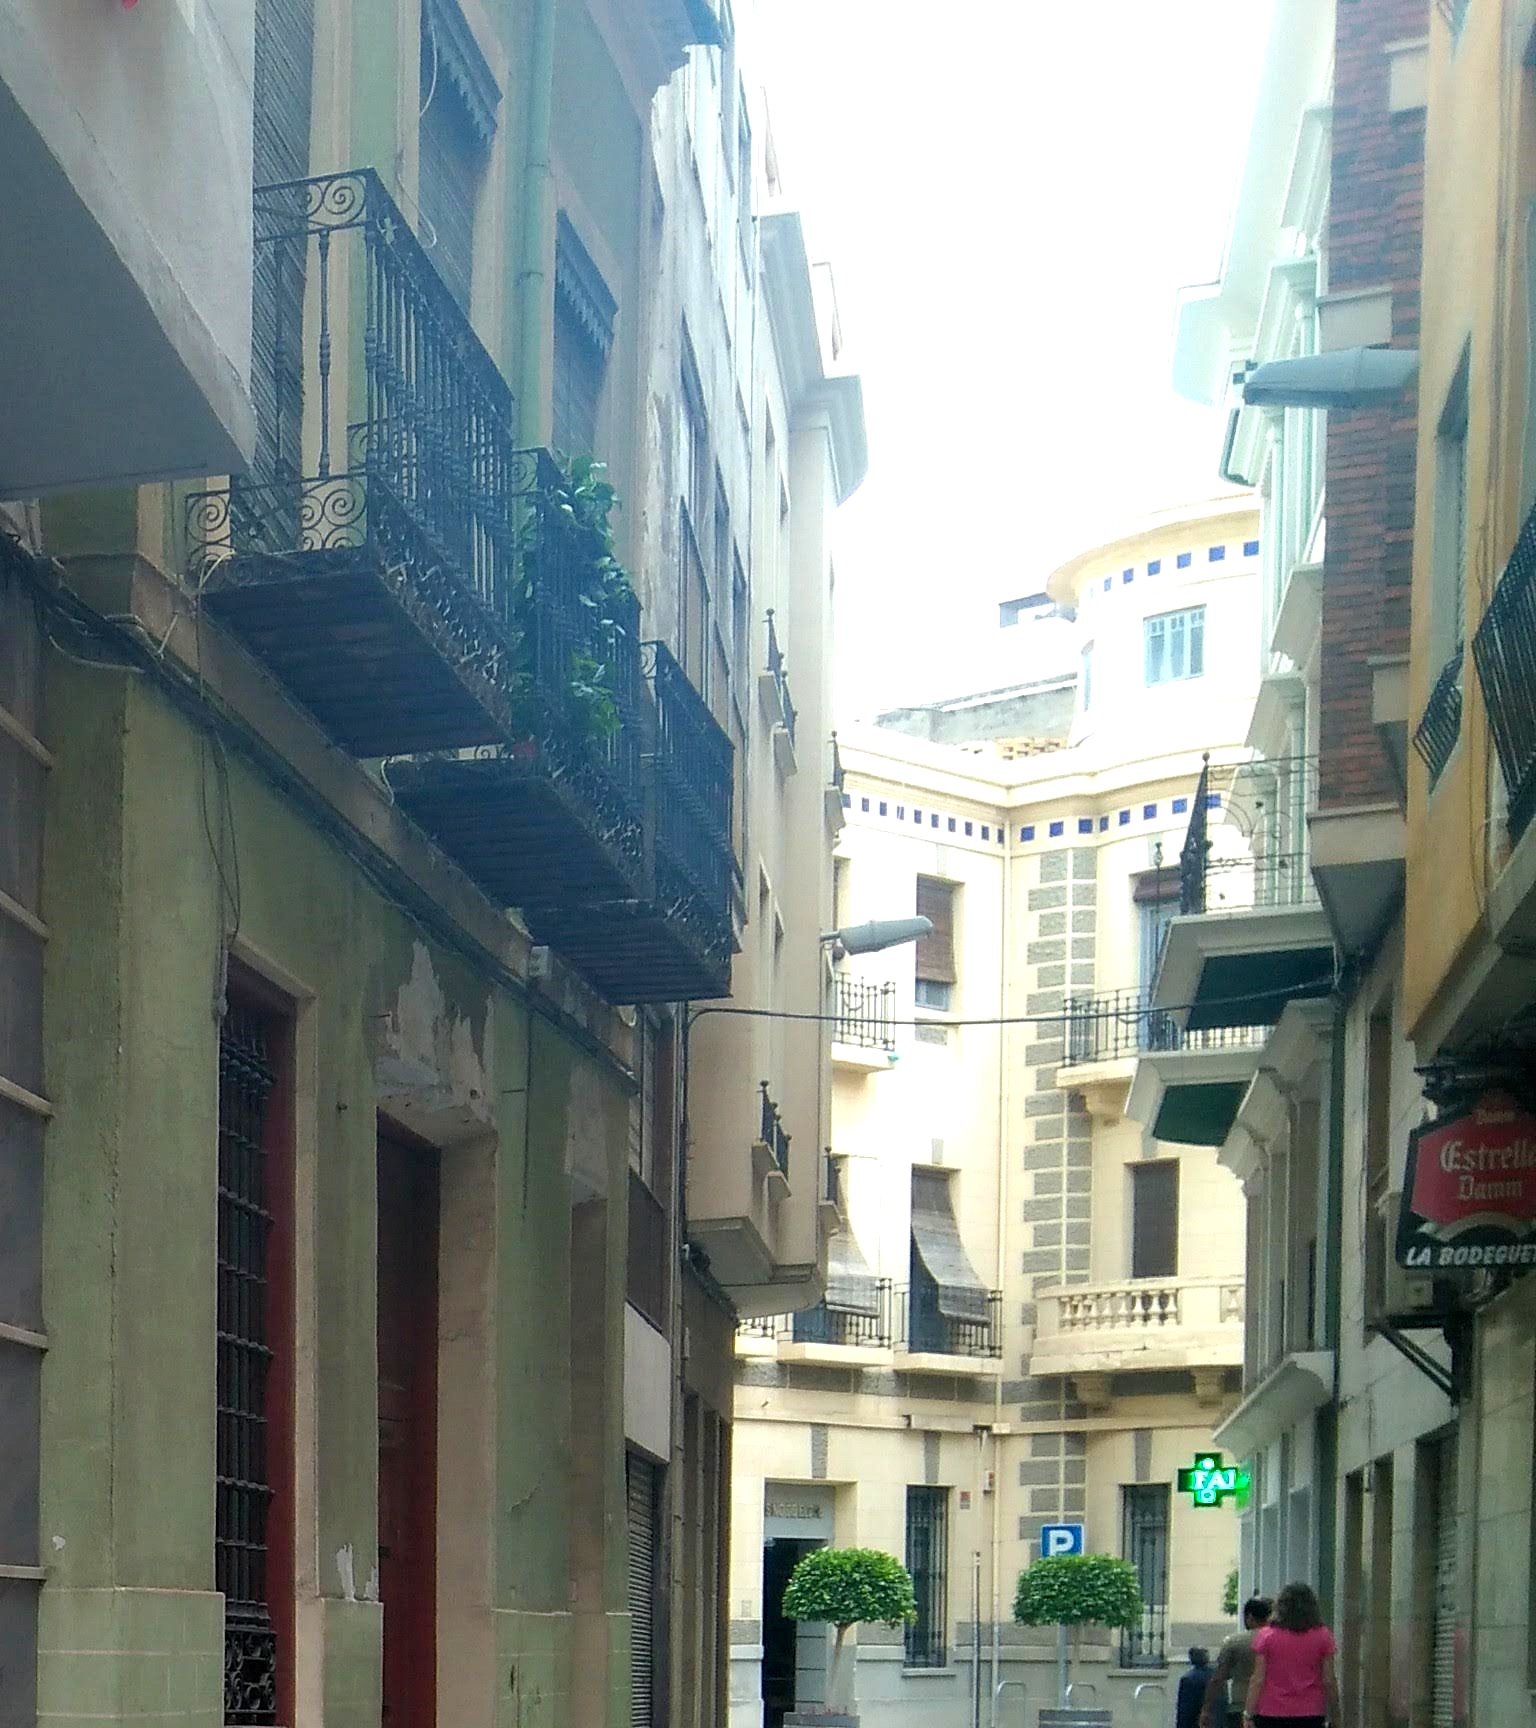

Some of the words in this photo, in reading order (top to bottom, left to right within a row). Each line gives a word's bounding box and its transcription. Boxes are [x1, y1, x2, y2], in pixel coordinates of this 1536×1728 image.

[1457, 1174, 1523, 1202] Damm
[1406, 1246, 1431, 1266] LA
[1048, 1529, 1075, 1556] P
